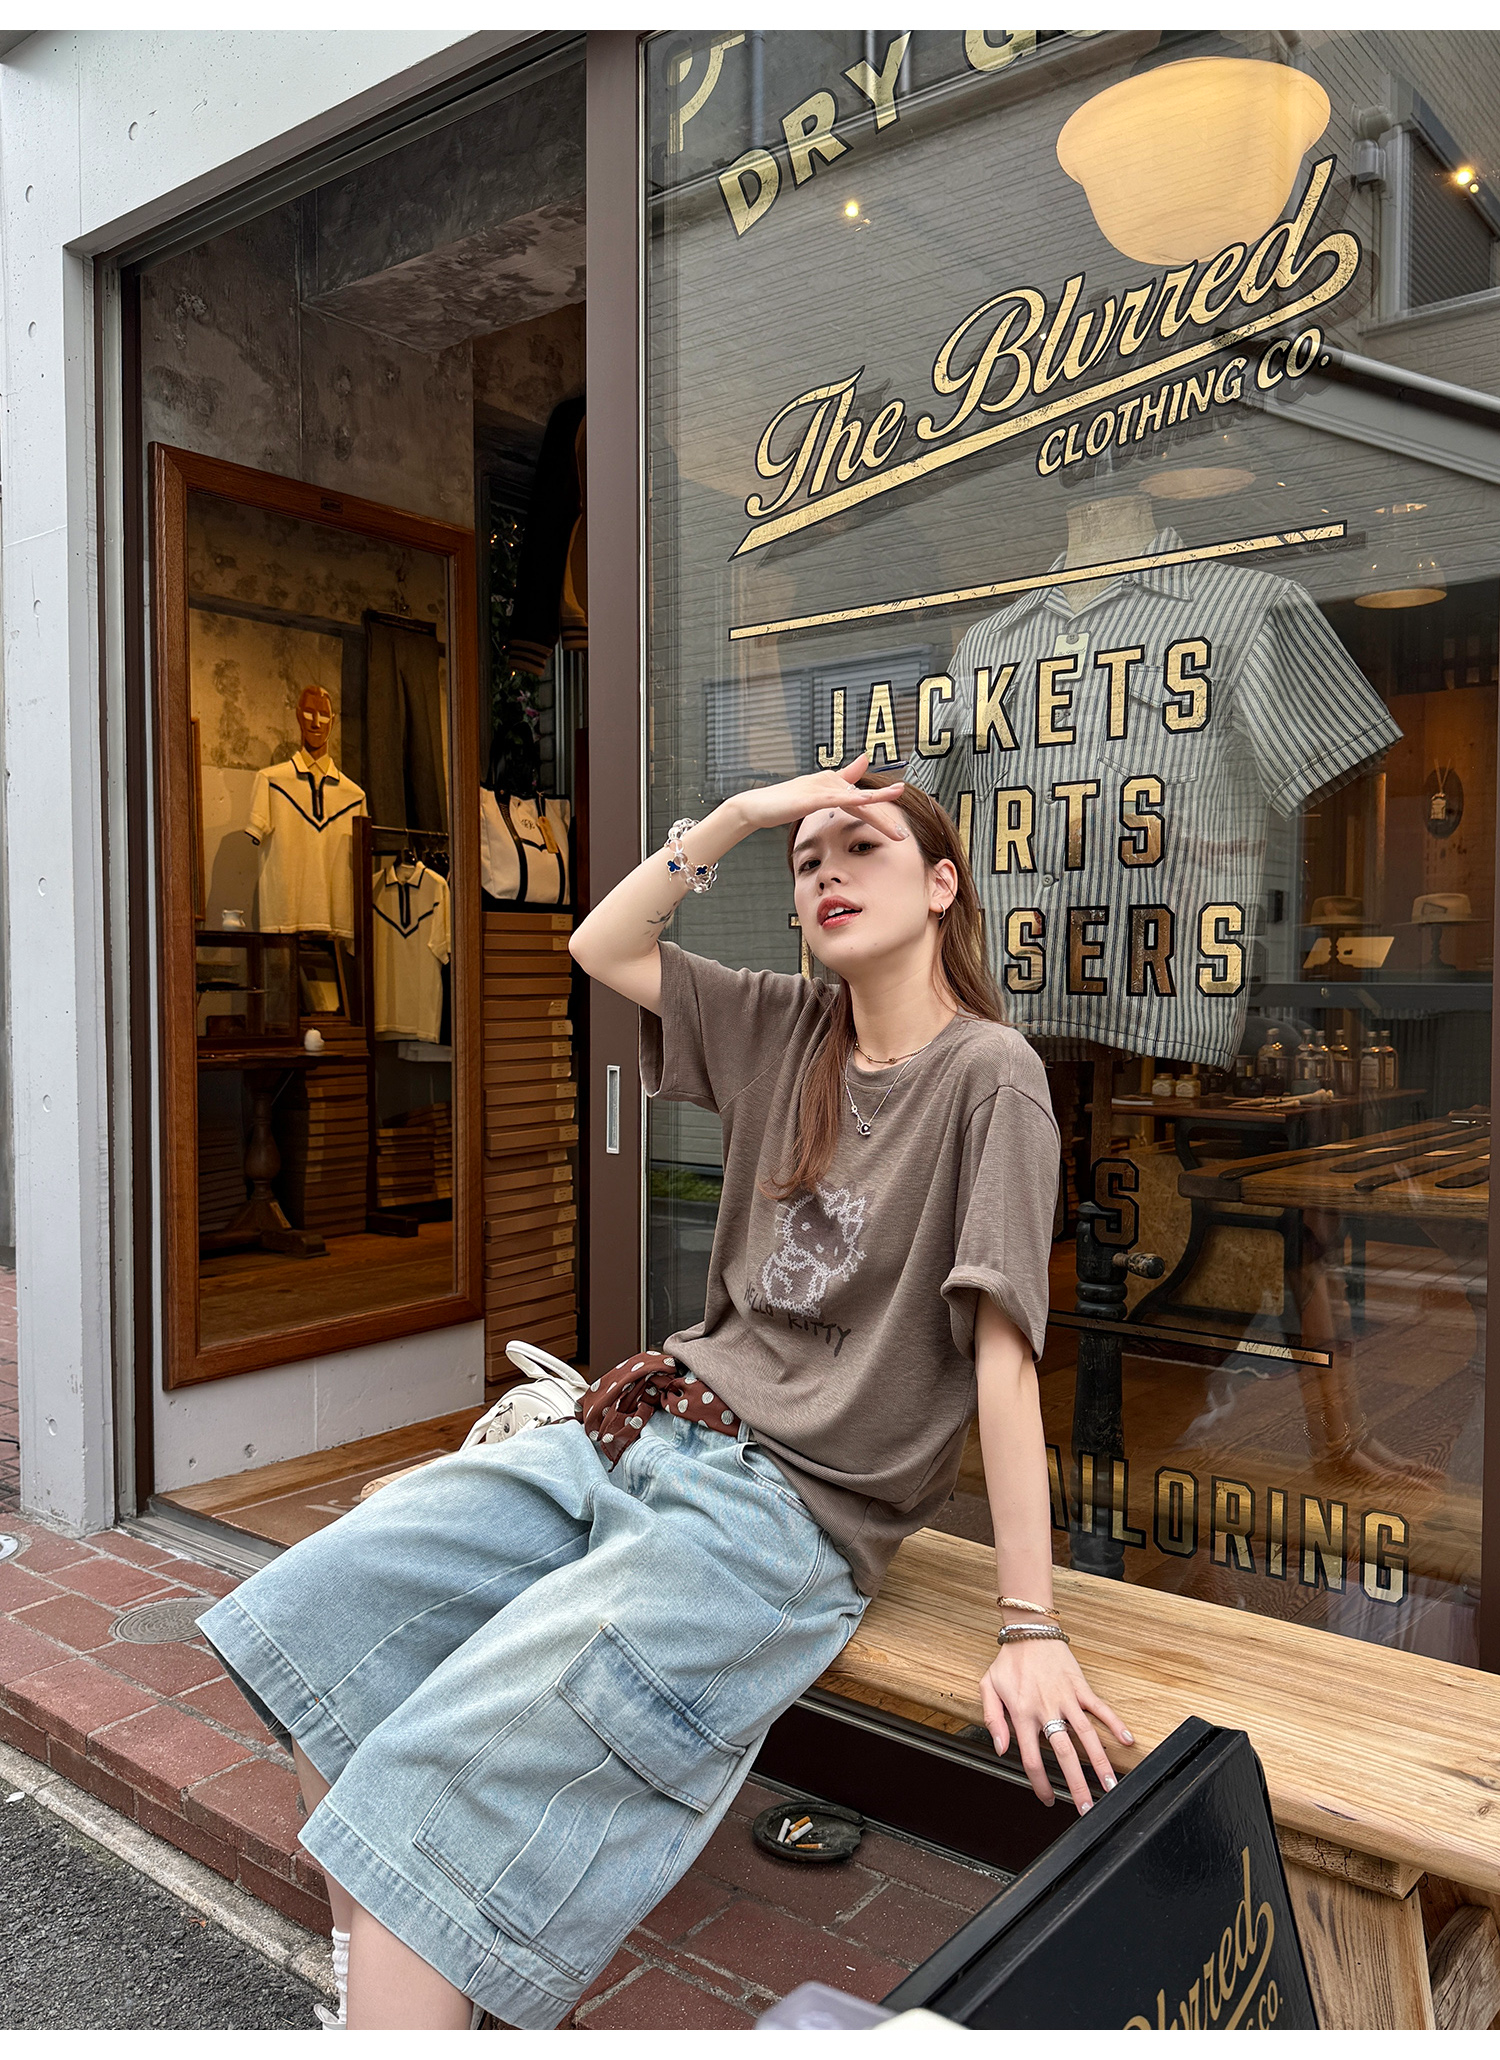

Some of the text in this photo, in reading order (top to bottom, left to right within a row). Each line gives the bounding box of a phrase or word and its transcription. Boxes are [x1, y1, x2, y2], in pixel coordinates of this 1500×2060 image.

[717, 31, 911, 240] DRY
[745, 365, 907, 519] The
[1037, 325, 1332, 478] CLOTHING CO.
[816, 637, 1212, 771] JACKETS
[787, 1312, 852, 1358] KITTY
